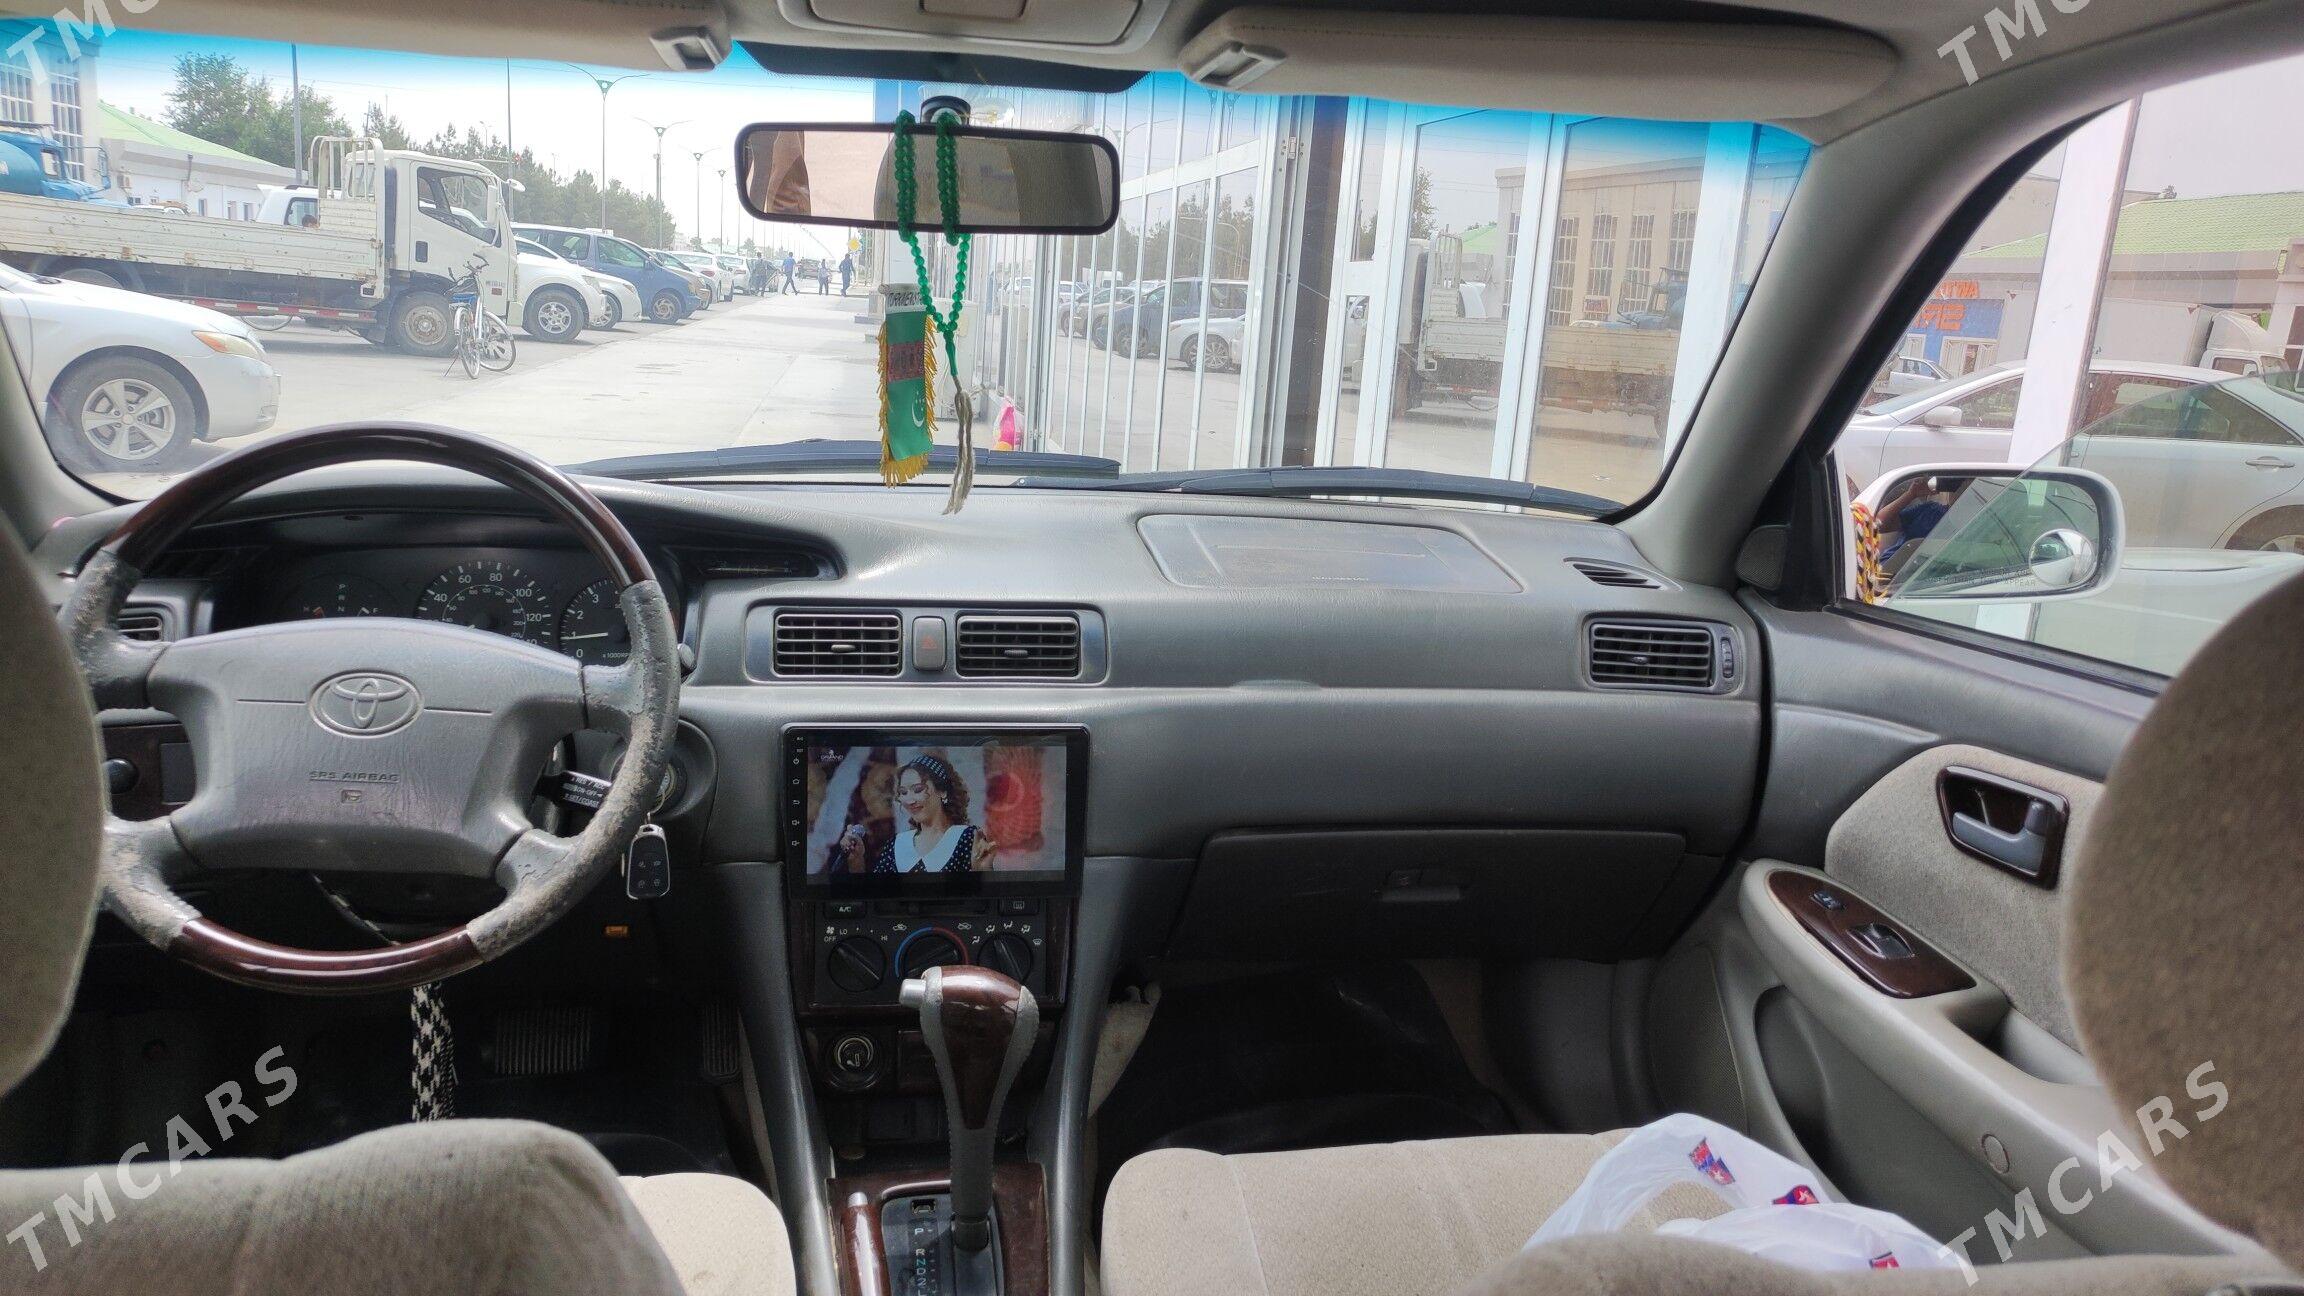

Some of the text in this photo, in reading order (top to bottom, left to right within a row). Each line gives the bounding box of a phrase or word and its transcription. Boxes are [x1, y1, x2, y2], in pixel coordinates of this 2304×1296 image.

[458, 574, 472, 584] 60
[489, 572, 503, 582] 80
[433, 593, 448, 602] 40
[515, 588, 532, 598] 100
[592, 594, 599, 603] 3
[526, 613, 542, 622] 120
[577, 610, 584, 619] 2
[576, 648, 583, 658] 0
[342, 772, 400, 782] AIRBAG
[914, 1227, 925, 1236] P
[915, 1248, 926, 1256] R
[915, 1258, 927, 1266] N
[917, 1277, 927, 1287] 2
